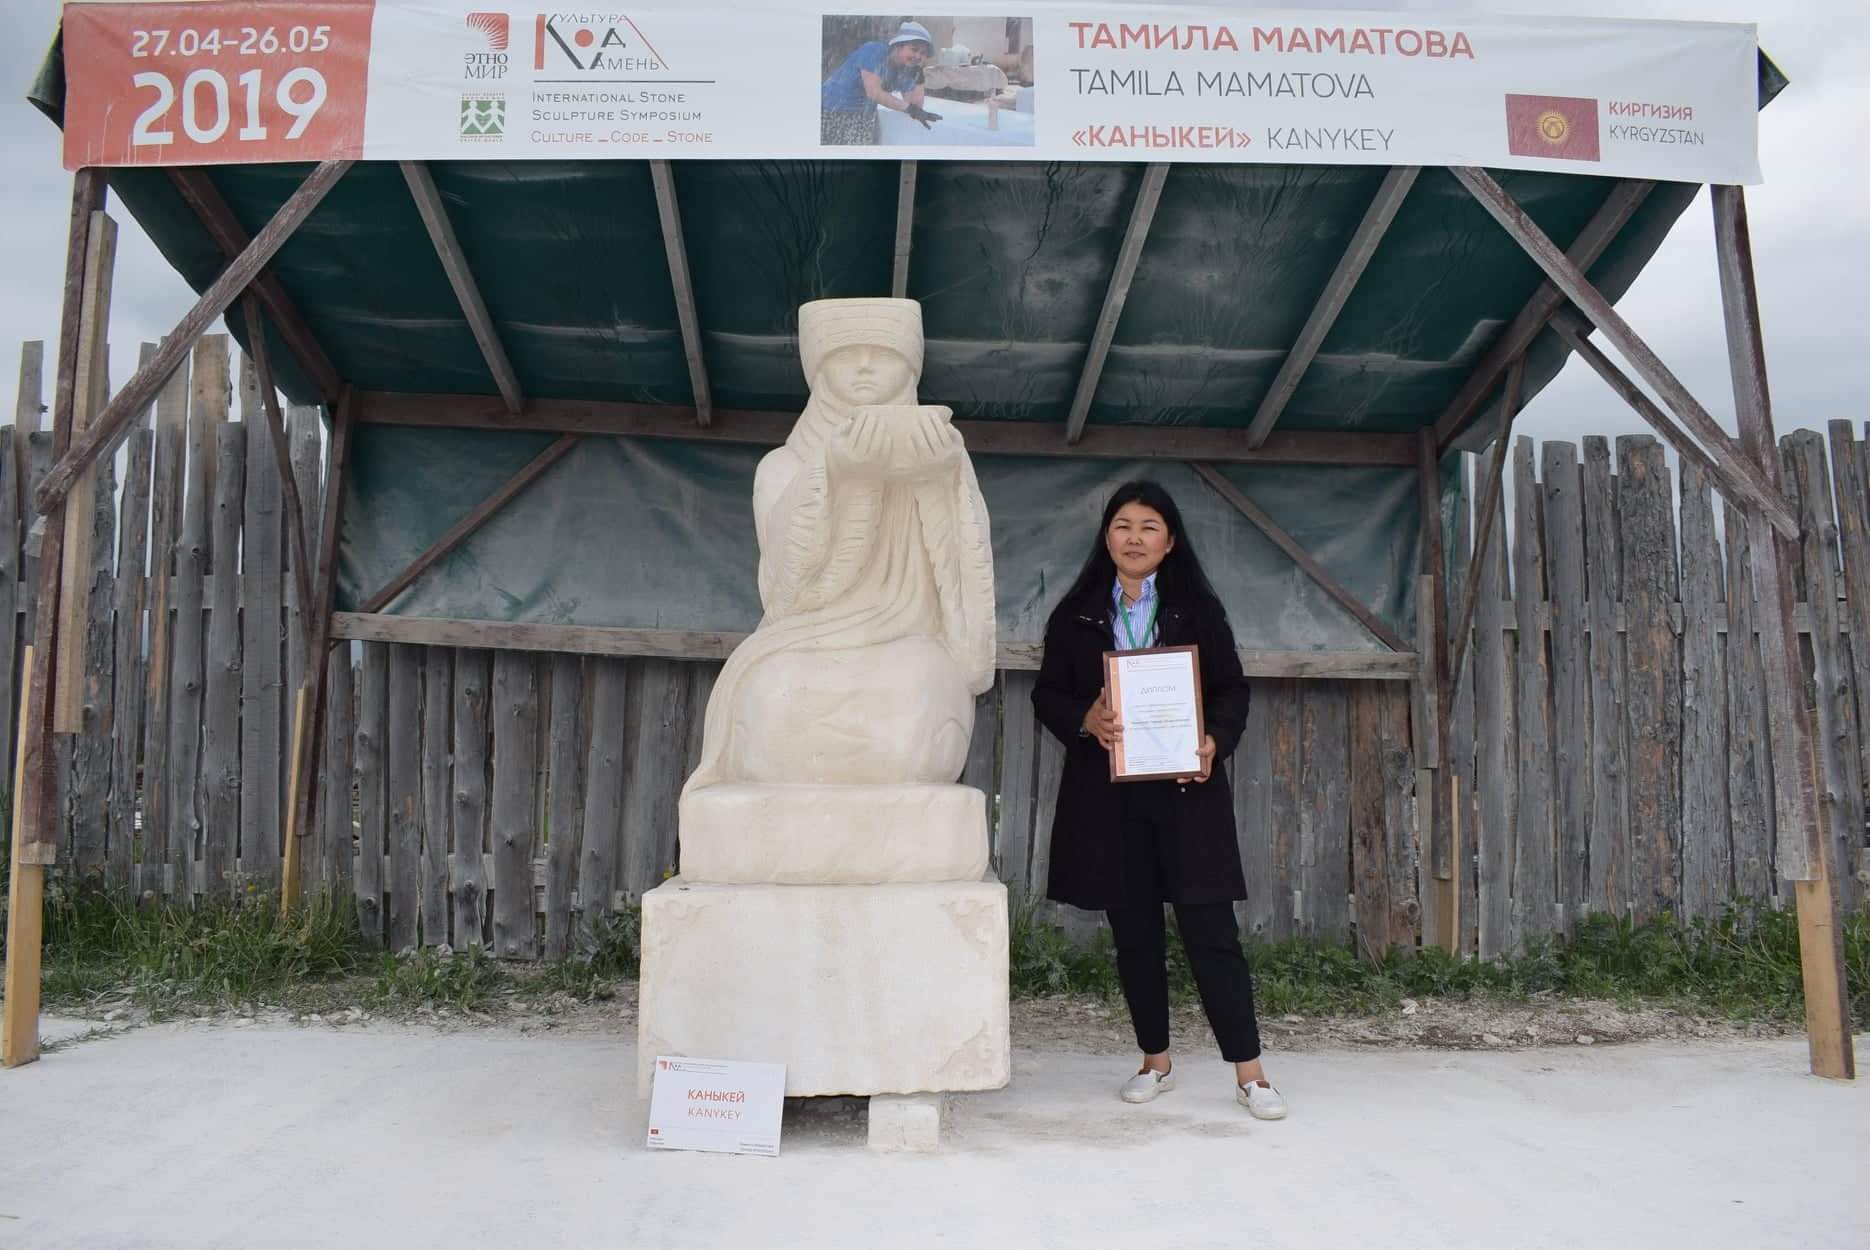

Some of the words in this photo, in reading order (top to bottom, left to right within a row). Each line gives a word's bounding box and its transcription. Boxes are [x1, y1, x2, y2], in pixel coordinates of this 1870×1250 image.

[1069, 22, 1239, 51] ТАМИЛА
[1252, 26, 1475, 59] МАМАТОВА
[464, 52, 508, 65] ЭТНО
[464, 65, 508, 79] МИР
[1069, 69, 1185, 97] TAMILA
[1197, 71, 1375, 99] MAMATOVA
[132, 67, 327, 146] 2019
[1609, 101, 1693, 121] КИРГИЗИЯ
[1072, 125, 1251, 148] «КАНЫКЕЙ»
[1267, 127, 1394, 151] KANYKEY
[1609, 124, 1705, 145] KYRGYZSTAN
[687, 1088, 745, 1103] КАНЫКЕЙ
[687, 1106, 741, 1120] KANYKEY
